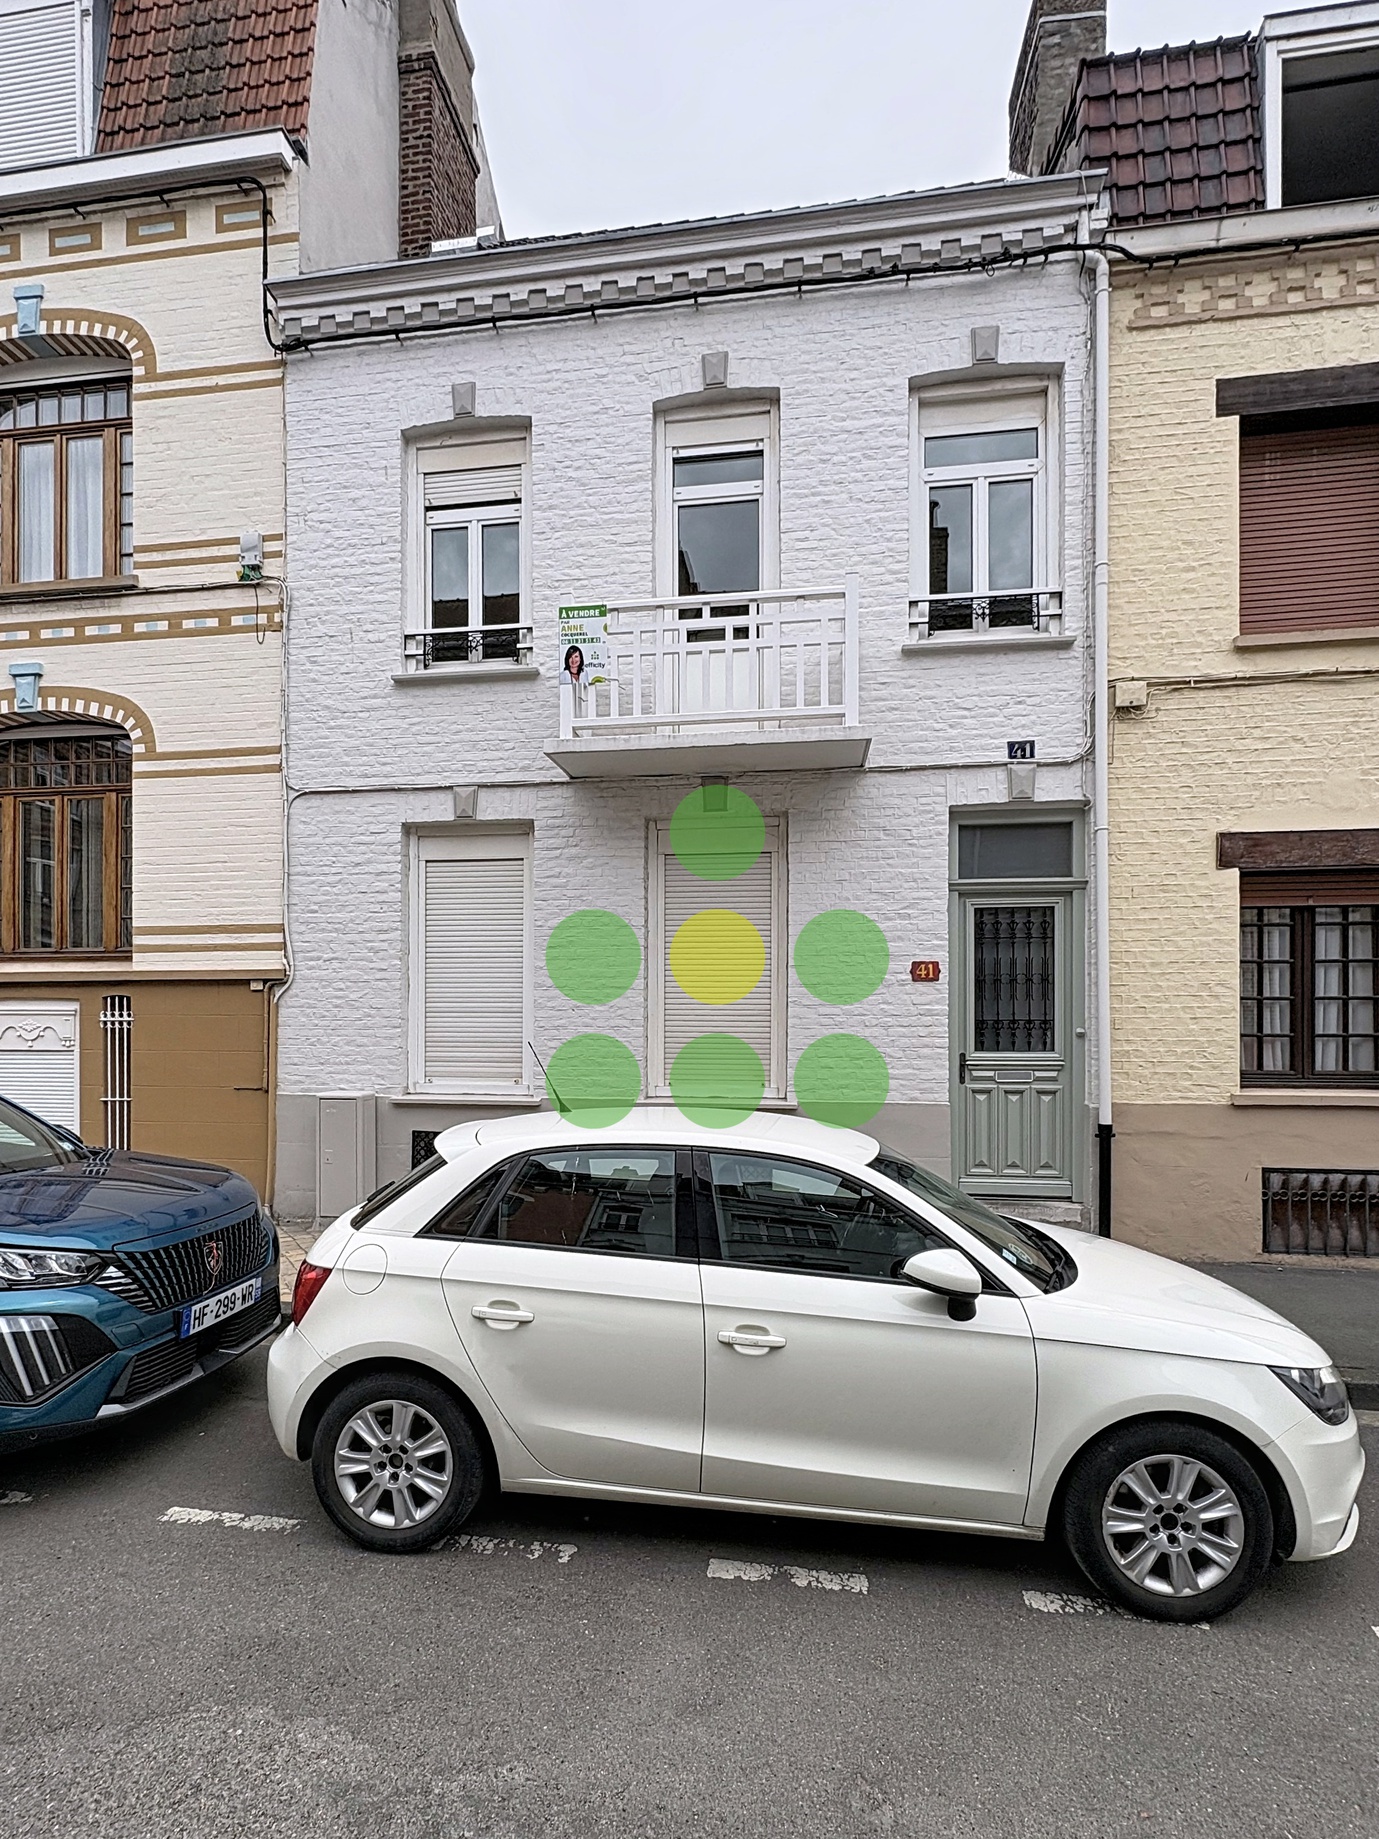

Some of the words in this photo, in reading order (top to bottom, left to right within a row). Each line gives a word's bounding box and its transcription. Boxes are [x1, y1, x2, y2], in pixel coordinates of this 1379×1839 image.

[561, 609, 567, 618] À
[568, 609, 600, 618] VENDRE
[1012, 743, 1031, 758] 41
[916, 964, 934, 978] 41
[192, 1283, 254, 1330] HF-299-WR
